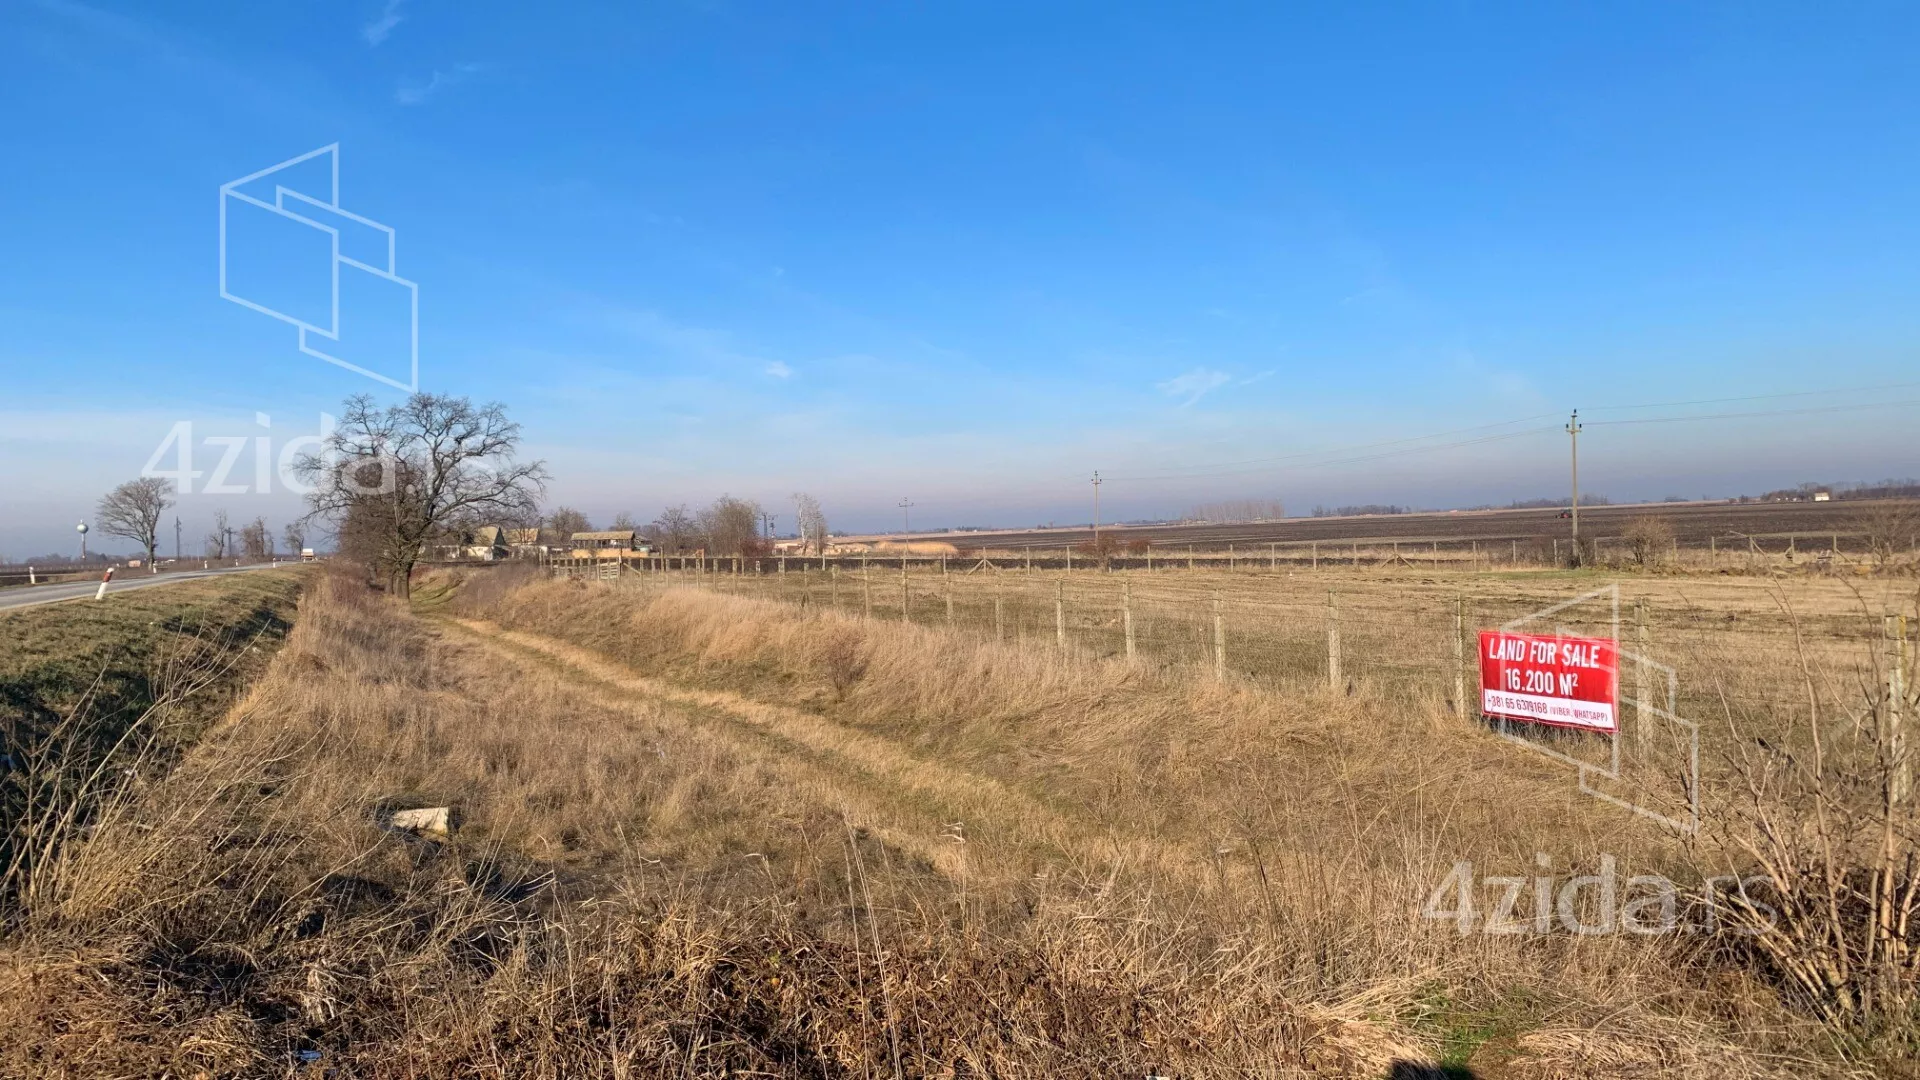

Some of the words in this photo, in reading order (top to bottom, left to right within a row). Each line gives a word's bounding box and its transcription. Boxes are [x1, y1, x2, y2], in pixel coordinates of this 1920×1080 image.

[1489, 638, 1526, 661] LAND
[1530, 642, 1557, 665] FOR
[1562, 644, 1601, 668] SALE
[1505, 668, 1554, 694] 16.200
[1560, 673, 1578, 696] M²
[1506, 698, 1515, 709] 65
[1573, 709, 1608, 722] WHATSAPP)
